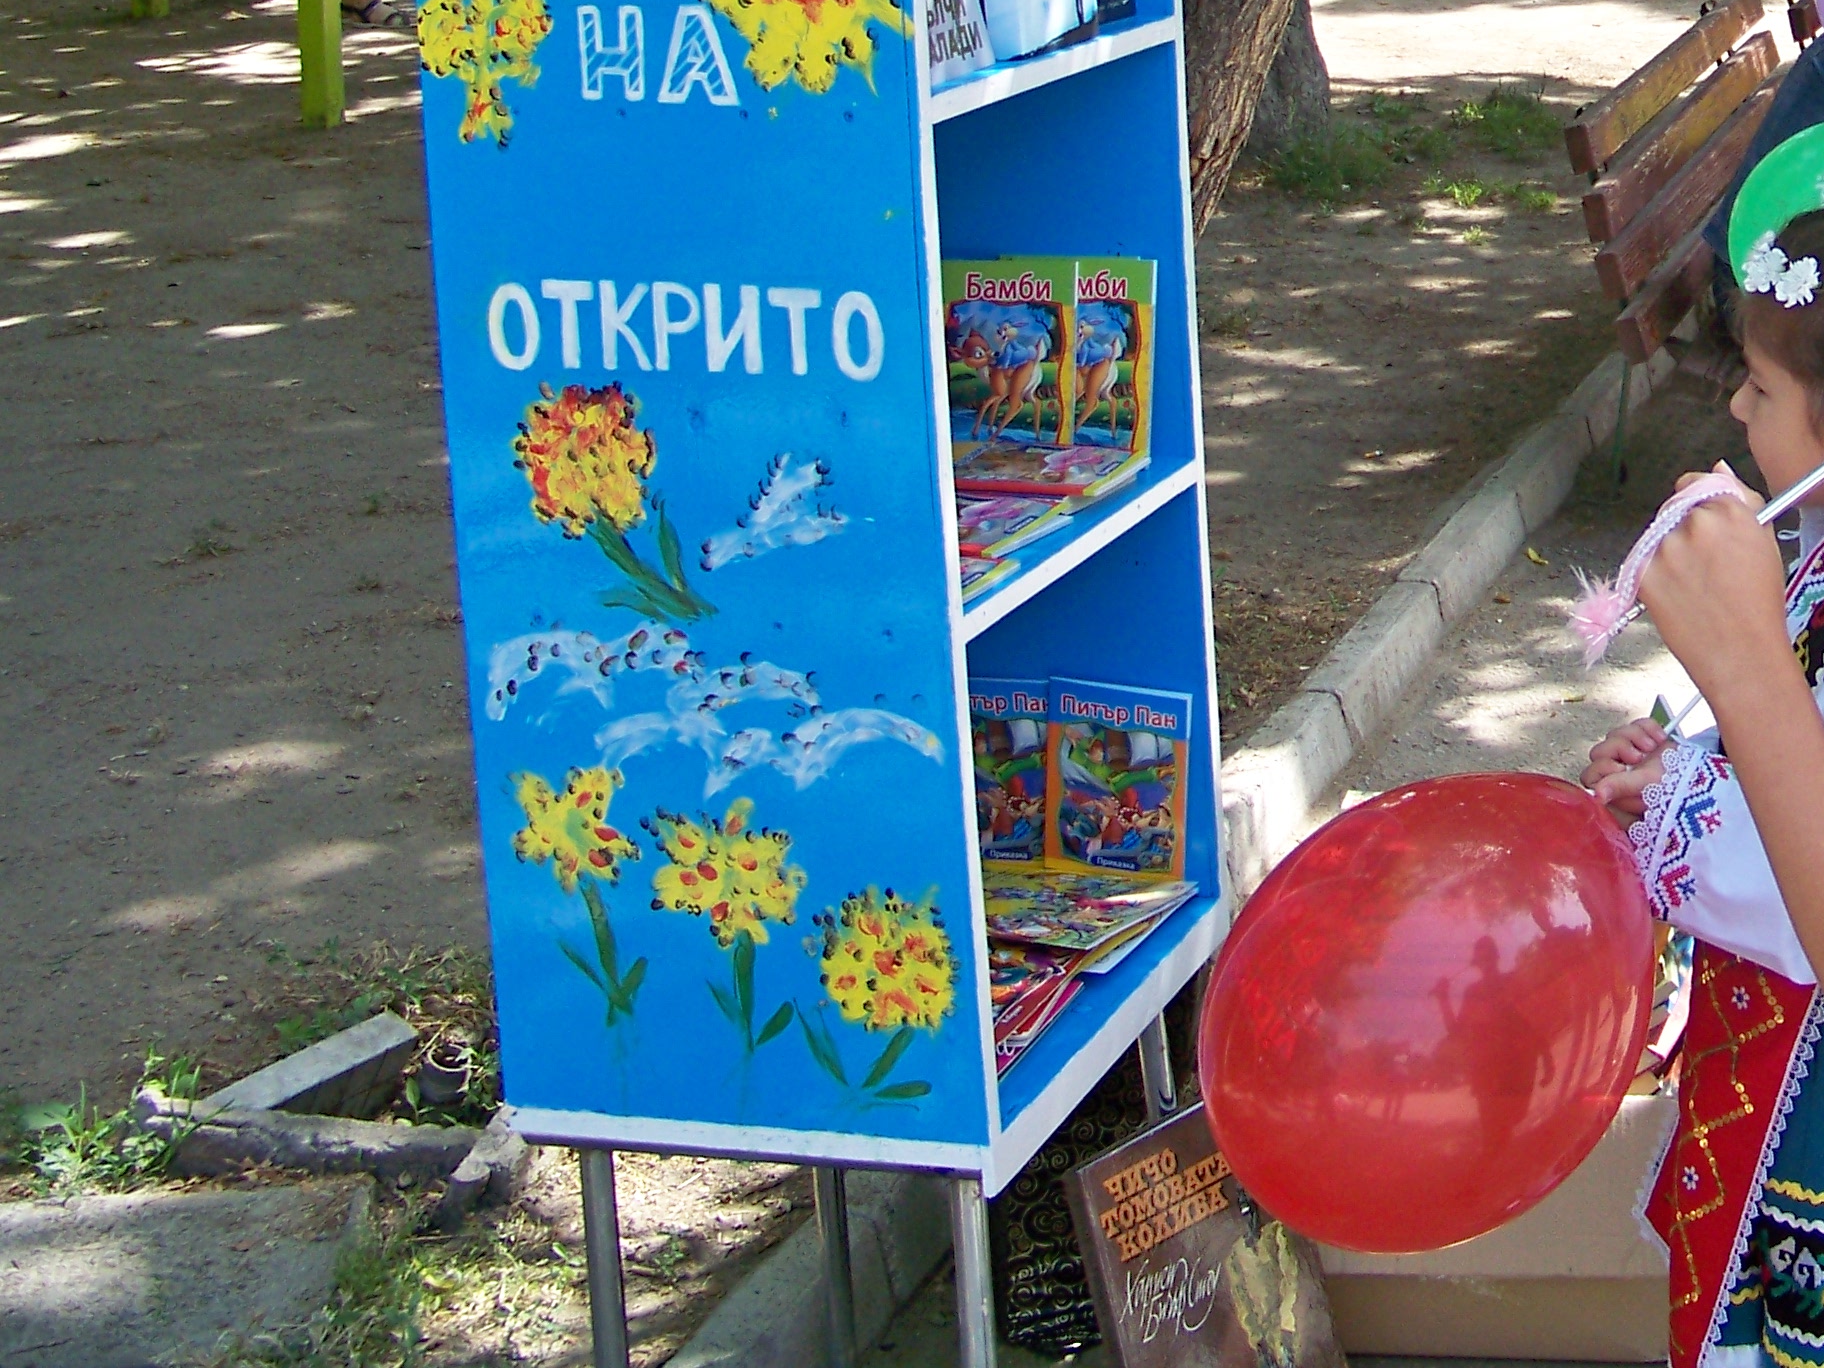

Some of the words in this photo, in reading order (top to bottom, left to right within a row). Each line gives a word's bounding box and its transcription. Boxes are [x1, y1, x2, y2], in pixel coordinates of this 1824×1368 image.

[577, 5, 740, 106] НА
[928, 21, 983, 69] АЛАДИ
[966, 271, 1052, 301] Бамби
[1078, 269, 1127, 300] мби
[487, 278, 885, 382] ОТКРИТО
[970, 692, 1007, 716] тър
[1060, 694, 1130, 726] Питър
[1134, 705, 1178, 729] Пан
[1098, 1151, 1233, 1239] ТОМОВАТА
[1102, 1147, 1178, 1203] ЧИЧО
[1115, 1182, 1229, 1263] КОЛИБА
